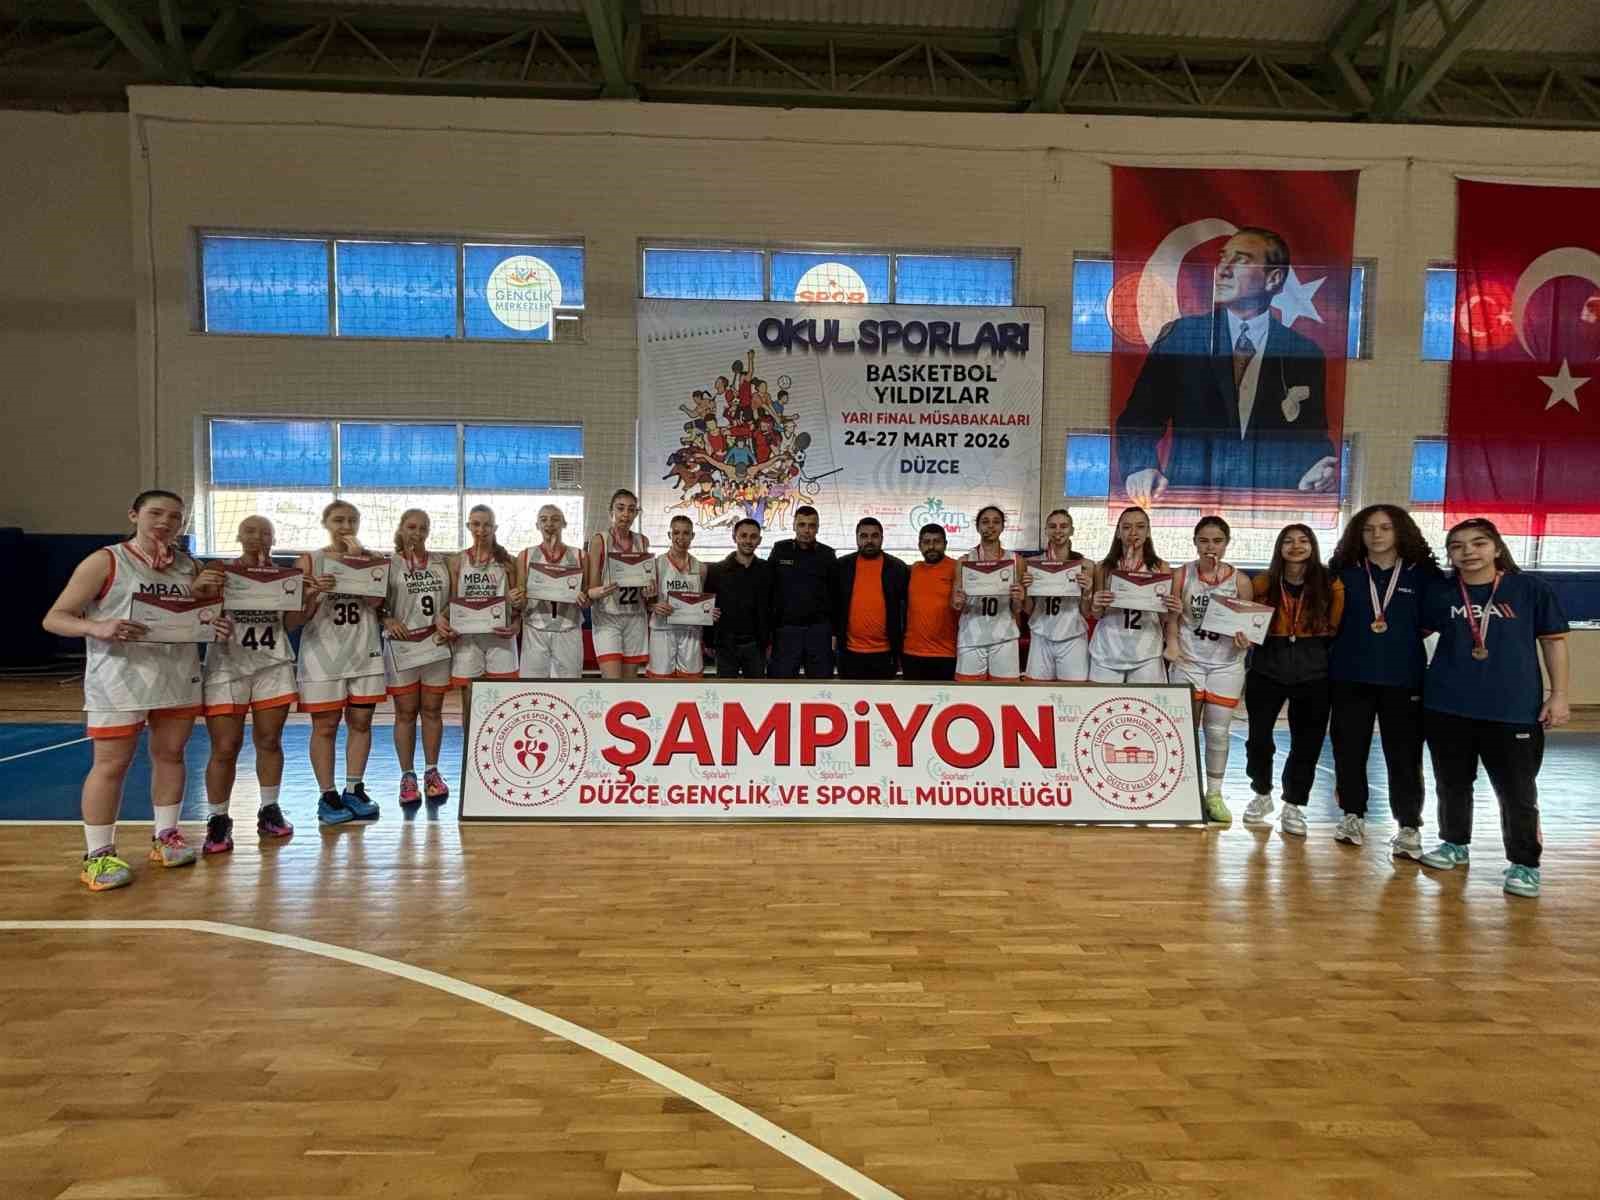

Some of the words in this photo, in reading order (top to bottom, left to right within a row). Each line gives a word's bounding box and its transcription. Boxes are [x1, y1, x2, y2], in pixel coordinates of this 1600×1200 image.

[757, 317, 854, 354] OKUL
[857, 319, 1030, 358] SPORLARI
[866, 364, 997, 382] BASKETBOL
[875, 386, 990, 404] YILDIZLAR
[841, 411, 872, 424] YARI
[919, 410, 1030, 426] MÜSABAKALARI
[844, 430, 898, 446] 24-27
[903, 432, 958, 448] MART
[964, 433, 1010, 448] 2026
[900, 455, 960, 474] DÜZCE
[403, 571, 433, 582] MBA
[464, 573, 490, 584] MBA
[666, 580, 689, 590] MBA
[139, 583, 183, 596] MBA
[619, 587, 638, 604] 22
[421, 595, 434, 616] 9
[981, 597, 998, 616] 10
[1045, 596, 1061, 616] 16
[1191, 594, 1209, 606] MB
[334, 602, 360, 625] 36
[1124, 609, 1142, 630] 12
[1451, 604, 1504, 619] MBA
[241, 625, 276, 650] 44
[579, 779, 660, 804] DÜZCE
[666, 779, 771, 811] GENÇLİK
[778, 785, 809, 804] VE
[816, 785, 881, 805] SPOR
[889, 780, 908, 805] İL
[916, 780, 1073, 807] MÜDÜRLÜĞÜ
